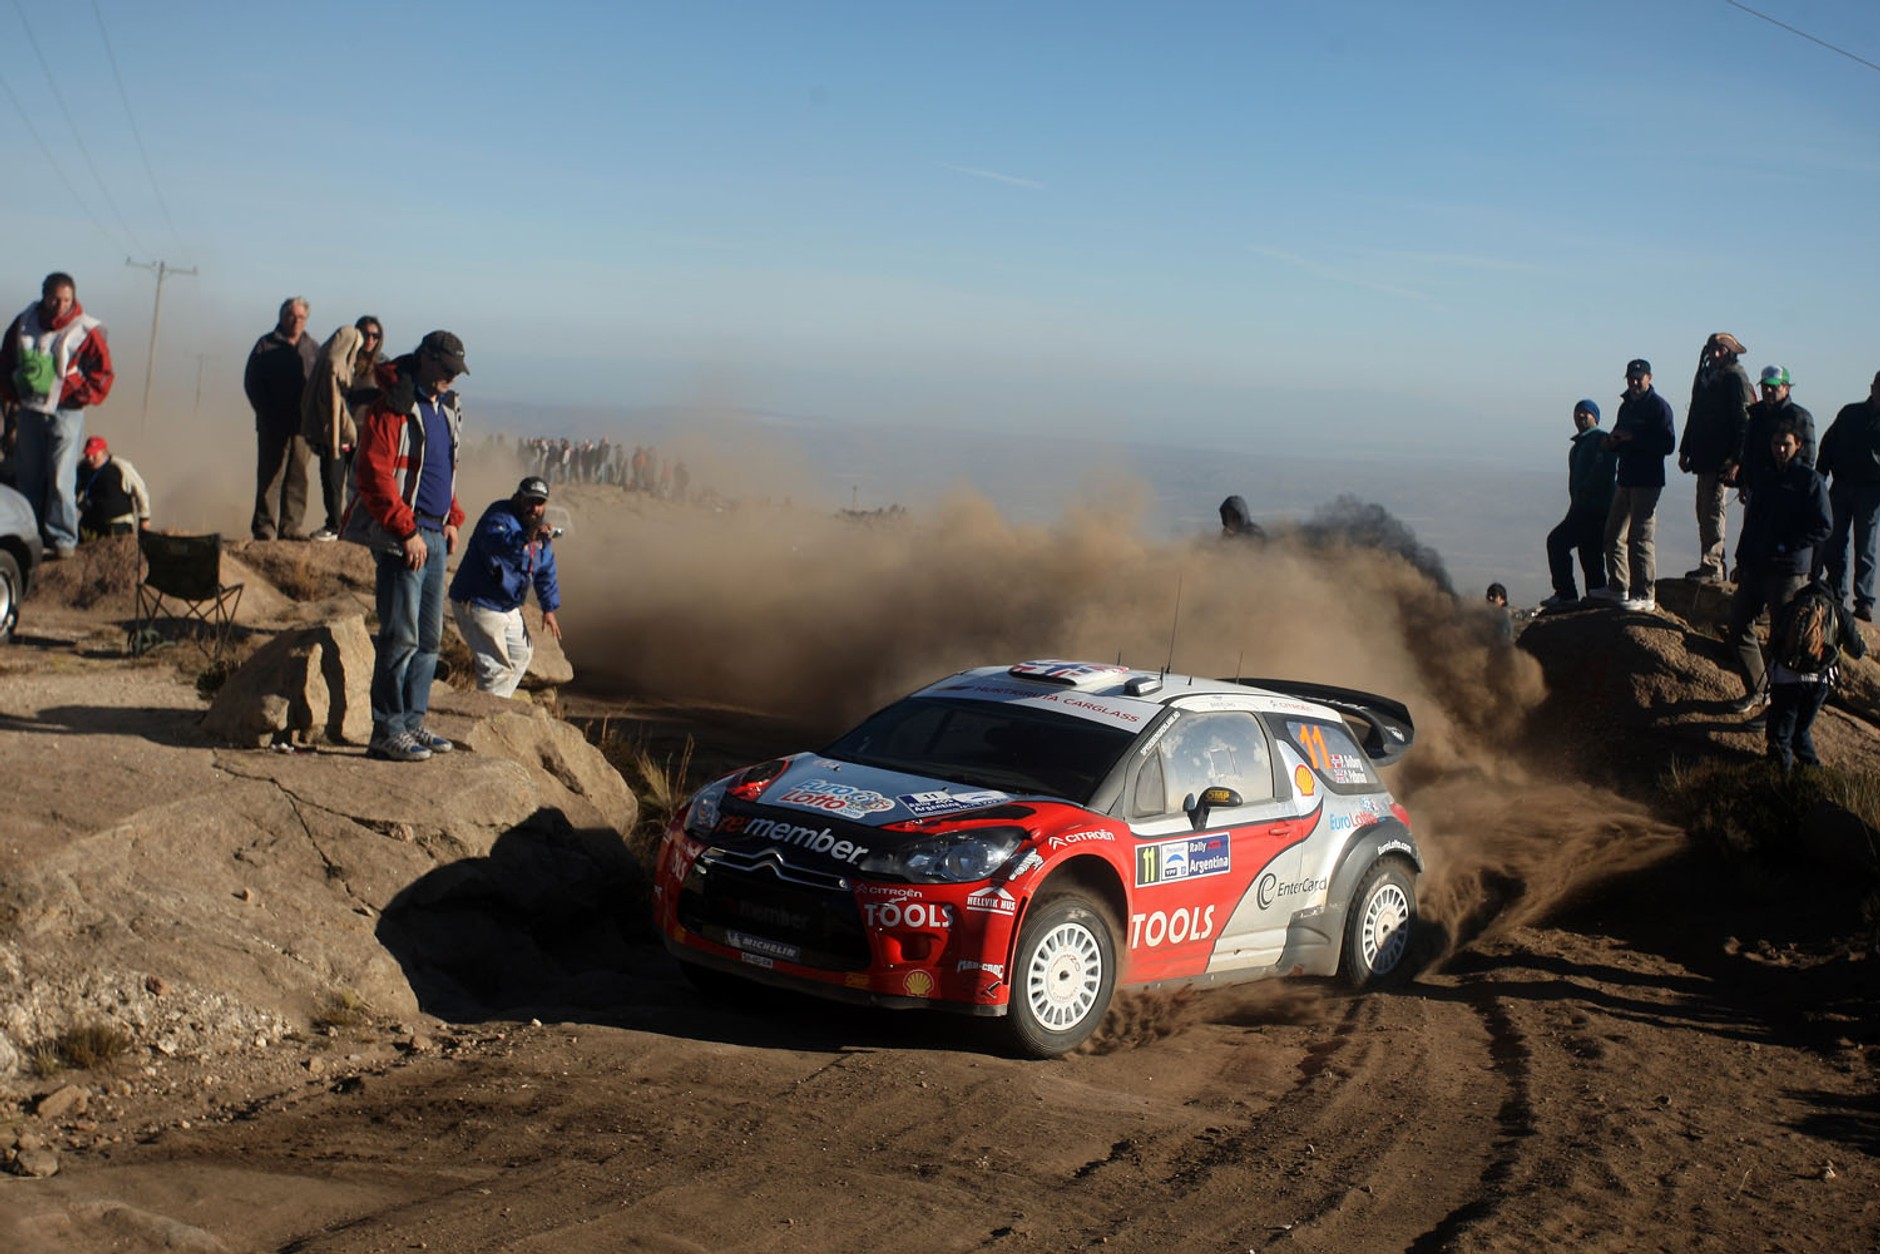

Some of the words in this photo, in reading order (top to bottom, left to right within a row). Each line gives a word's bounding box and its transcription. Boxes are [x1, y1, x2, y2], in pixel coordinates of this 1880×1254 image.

[1063, 697, 1140, 723] CARGLASS
[1299, 724, 1332, 770] 11
[796, 780, 854, 796] Euro
[1206, 790, 1230, 801] OMP
[780, 790, 846, 810] Lotto
[1189, 840, 1207, 852] Rally
[1143, 846, 1156, 883] 11
[1189, 855, 1228, 873] Argentina
[1277, 876, 1327, 897] EnterCard
[966, 896, 997, 908] HELLVIK
[1000, 900, 1016, 911] HUS
[864, 902, 954, 928] TOOLS
[1131, 904, 1215, 950] TOOLS
[742, 937, 797, 957] MICHELIN
